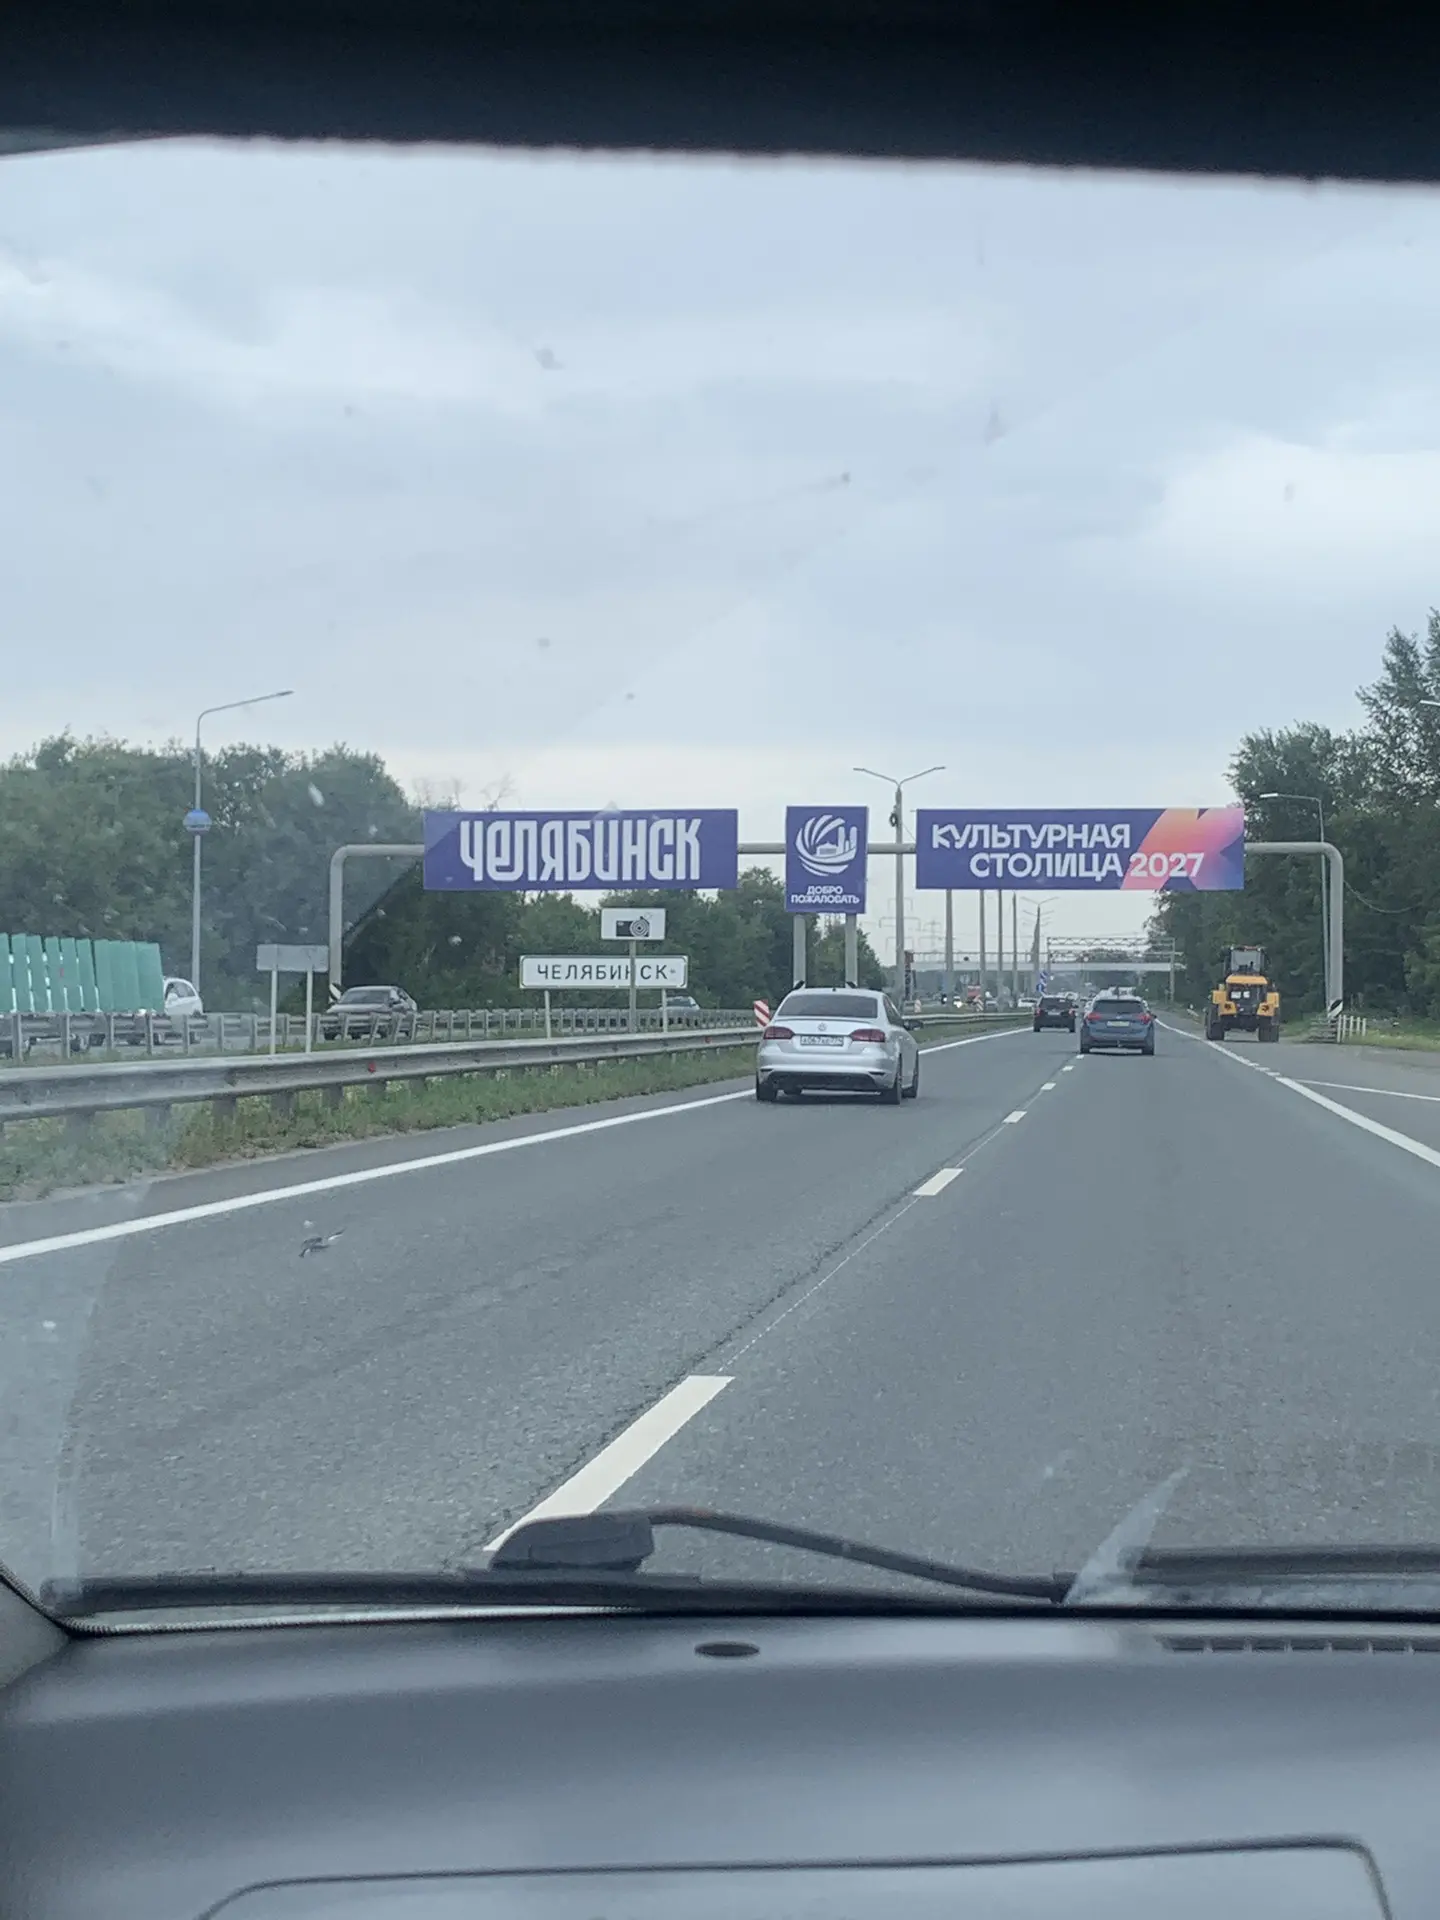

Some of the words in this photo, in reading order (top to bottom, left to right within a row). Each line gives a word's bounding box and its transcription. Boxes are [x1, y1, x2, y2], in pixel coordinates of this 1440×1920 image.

[931, 823, 1130, 849] КУЛЬТУРНАЯ
[969, 852, 1124, 881] СТОЛИЦА
[1129, 852, 1205, 878] 2027
[806, 885, 844, 896] ДОБРО
